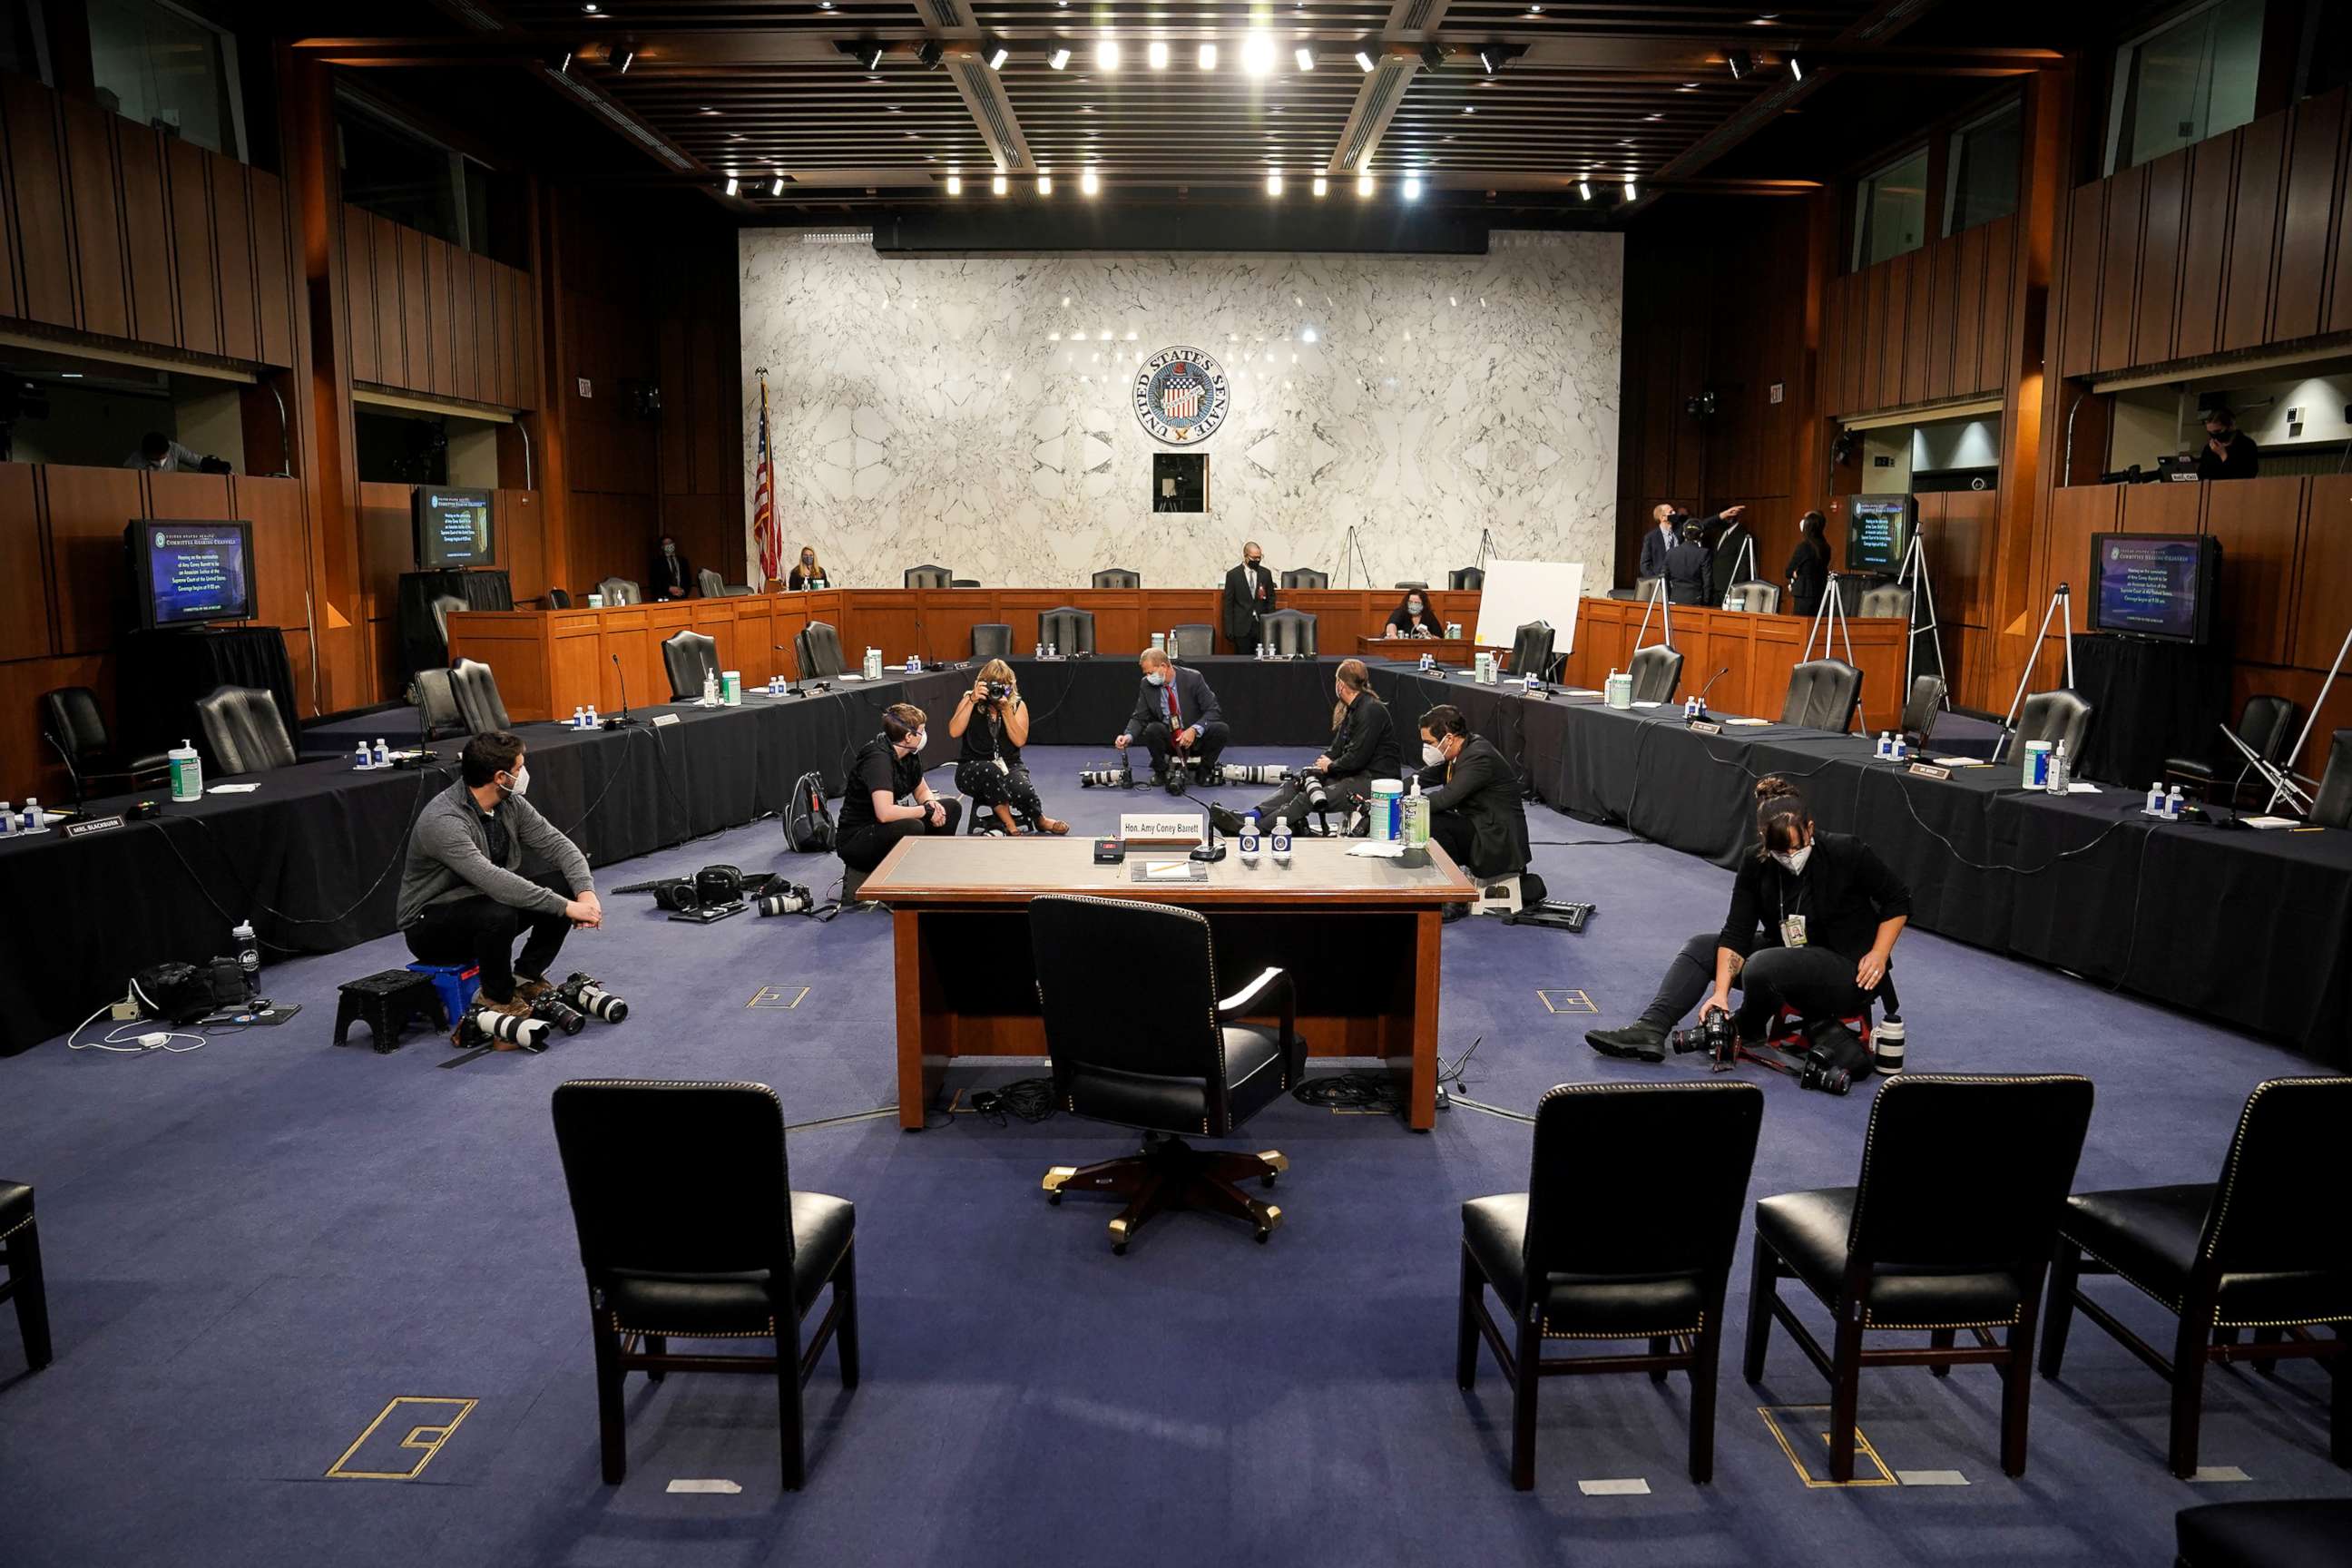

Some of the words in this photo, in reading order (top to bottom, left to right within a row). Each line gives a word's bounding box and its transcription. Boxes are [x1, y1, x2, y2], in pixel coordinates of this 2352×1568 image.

[1150, 350, 1213, 371] STATES
[1137, 374, 1168, 436] UNITED
[1193, 375, 1226, 436] SENATE
[1125, 824, 1139, 833] Hon.
[1141, 824, 1154, 835] Amy
[1156, 824, 1176, 835] Coney
[1178, 824, 1199, 833] Barrett
